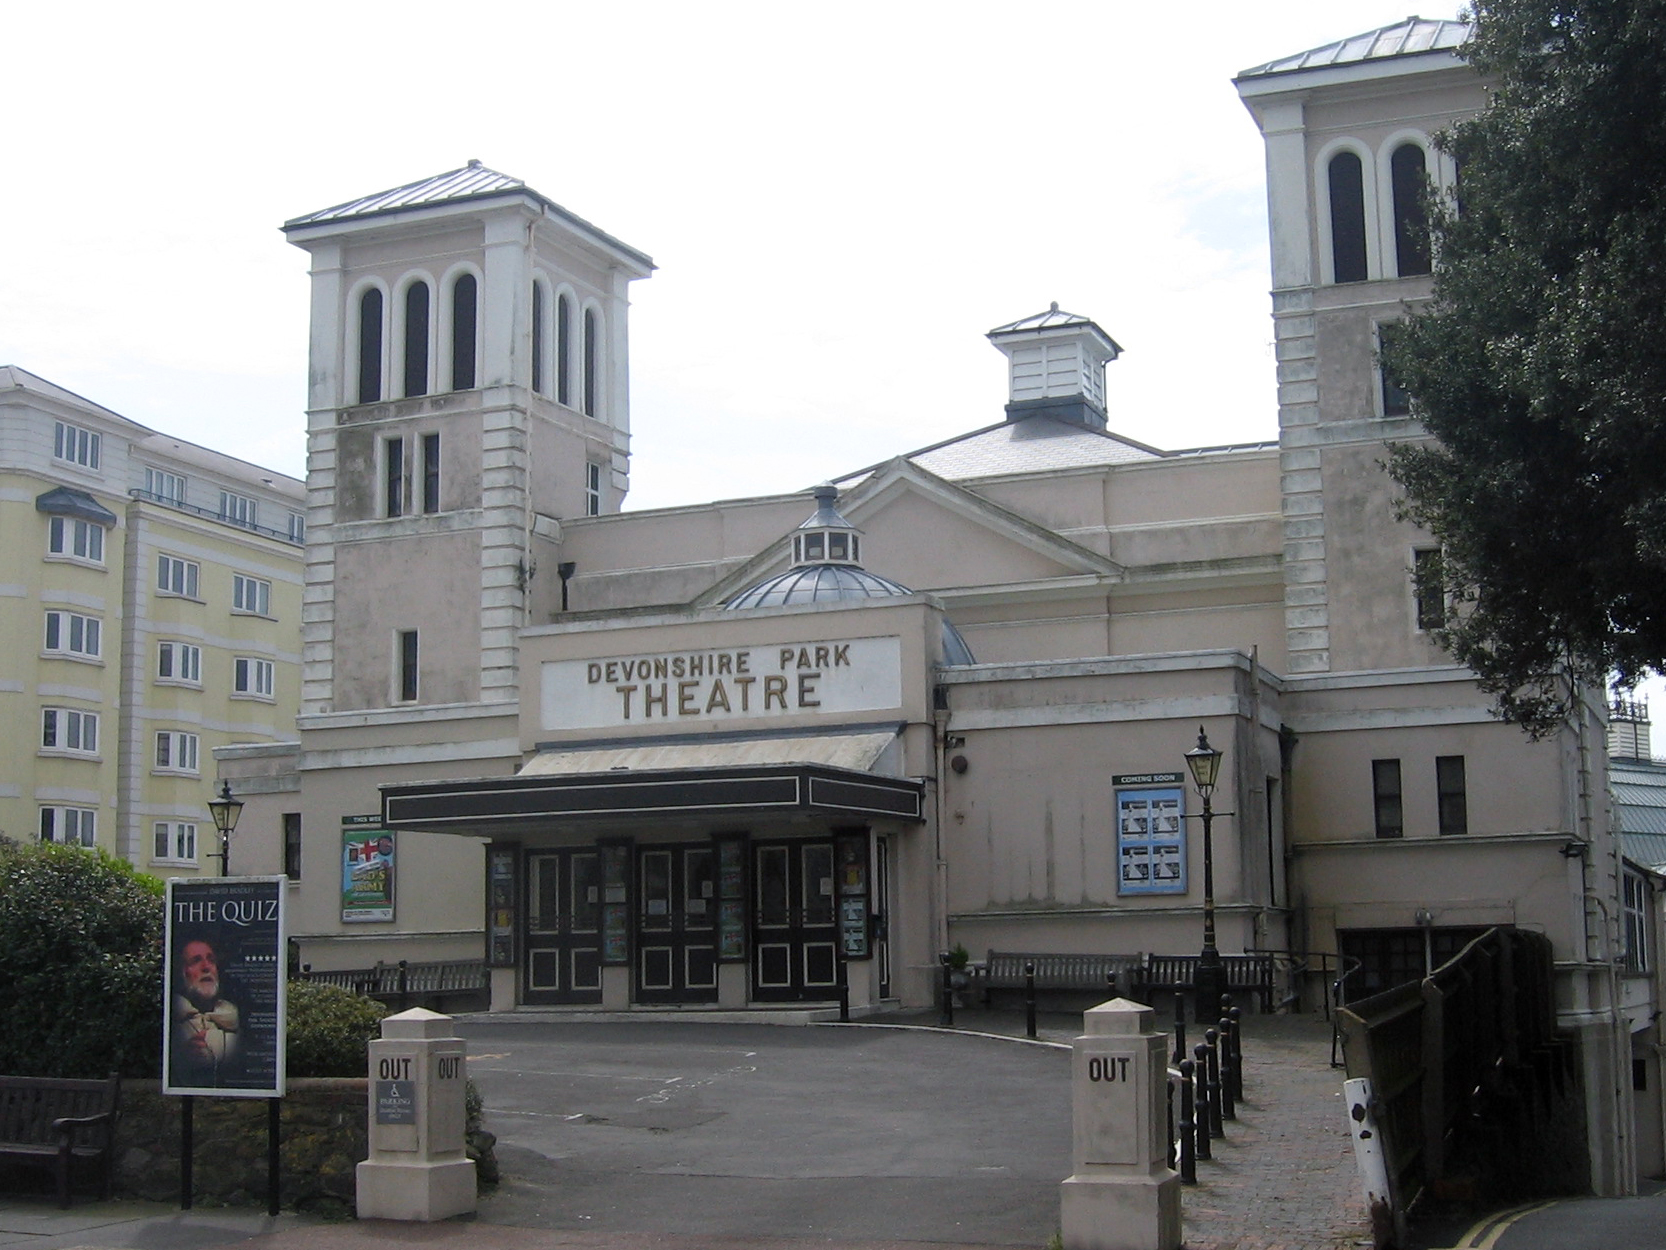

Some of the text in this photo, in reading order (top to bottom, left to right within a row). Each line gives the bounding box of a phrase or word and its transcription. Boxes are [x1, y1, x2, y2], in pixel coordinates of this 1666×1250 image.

[588, 644, 851, 685] DEVONSHIRE PARK
[615, 671, 822, 720] THEATRE
[1121, 774, 1176, 784] COMING SOON
[175, 900, 278, 927] THE QUIZ
[380, 1058, 412, 1081] OUT
[439, 1057, 461, 1080] OUT
[1089, 1057, 1131, 1082] OUT
